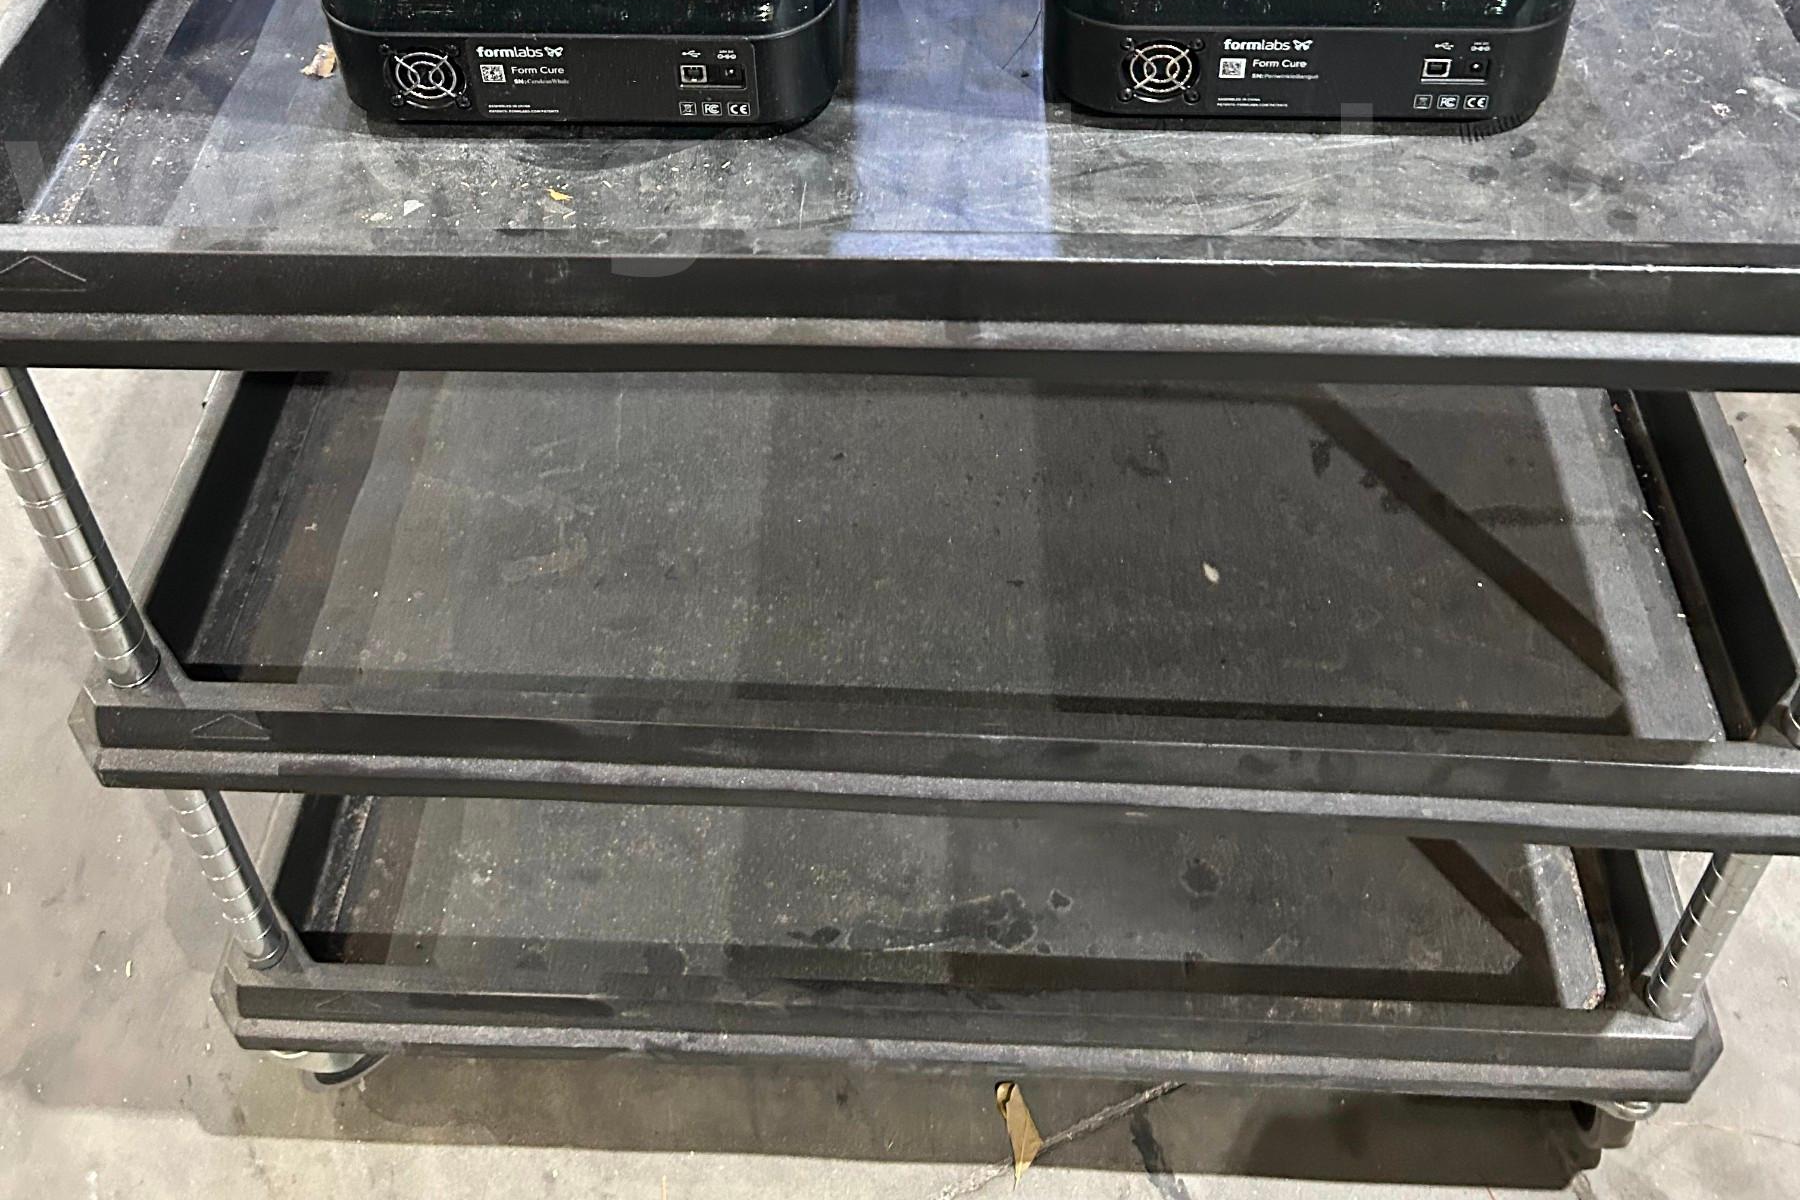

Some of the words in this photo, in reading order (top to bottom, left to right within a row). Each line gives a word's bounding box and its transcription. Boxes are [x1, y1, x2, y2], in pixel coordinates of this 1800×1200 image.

[1223, 38, 1291, 51] formlabs
[475, 45, 544, 58] formlabs
[1252, 59, 1279, 68] Form
[1282, 59, 1308, 68] Cure
[510, 66, 538, 75] Form
[540, 66, 565, 75] Cure
